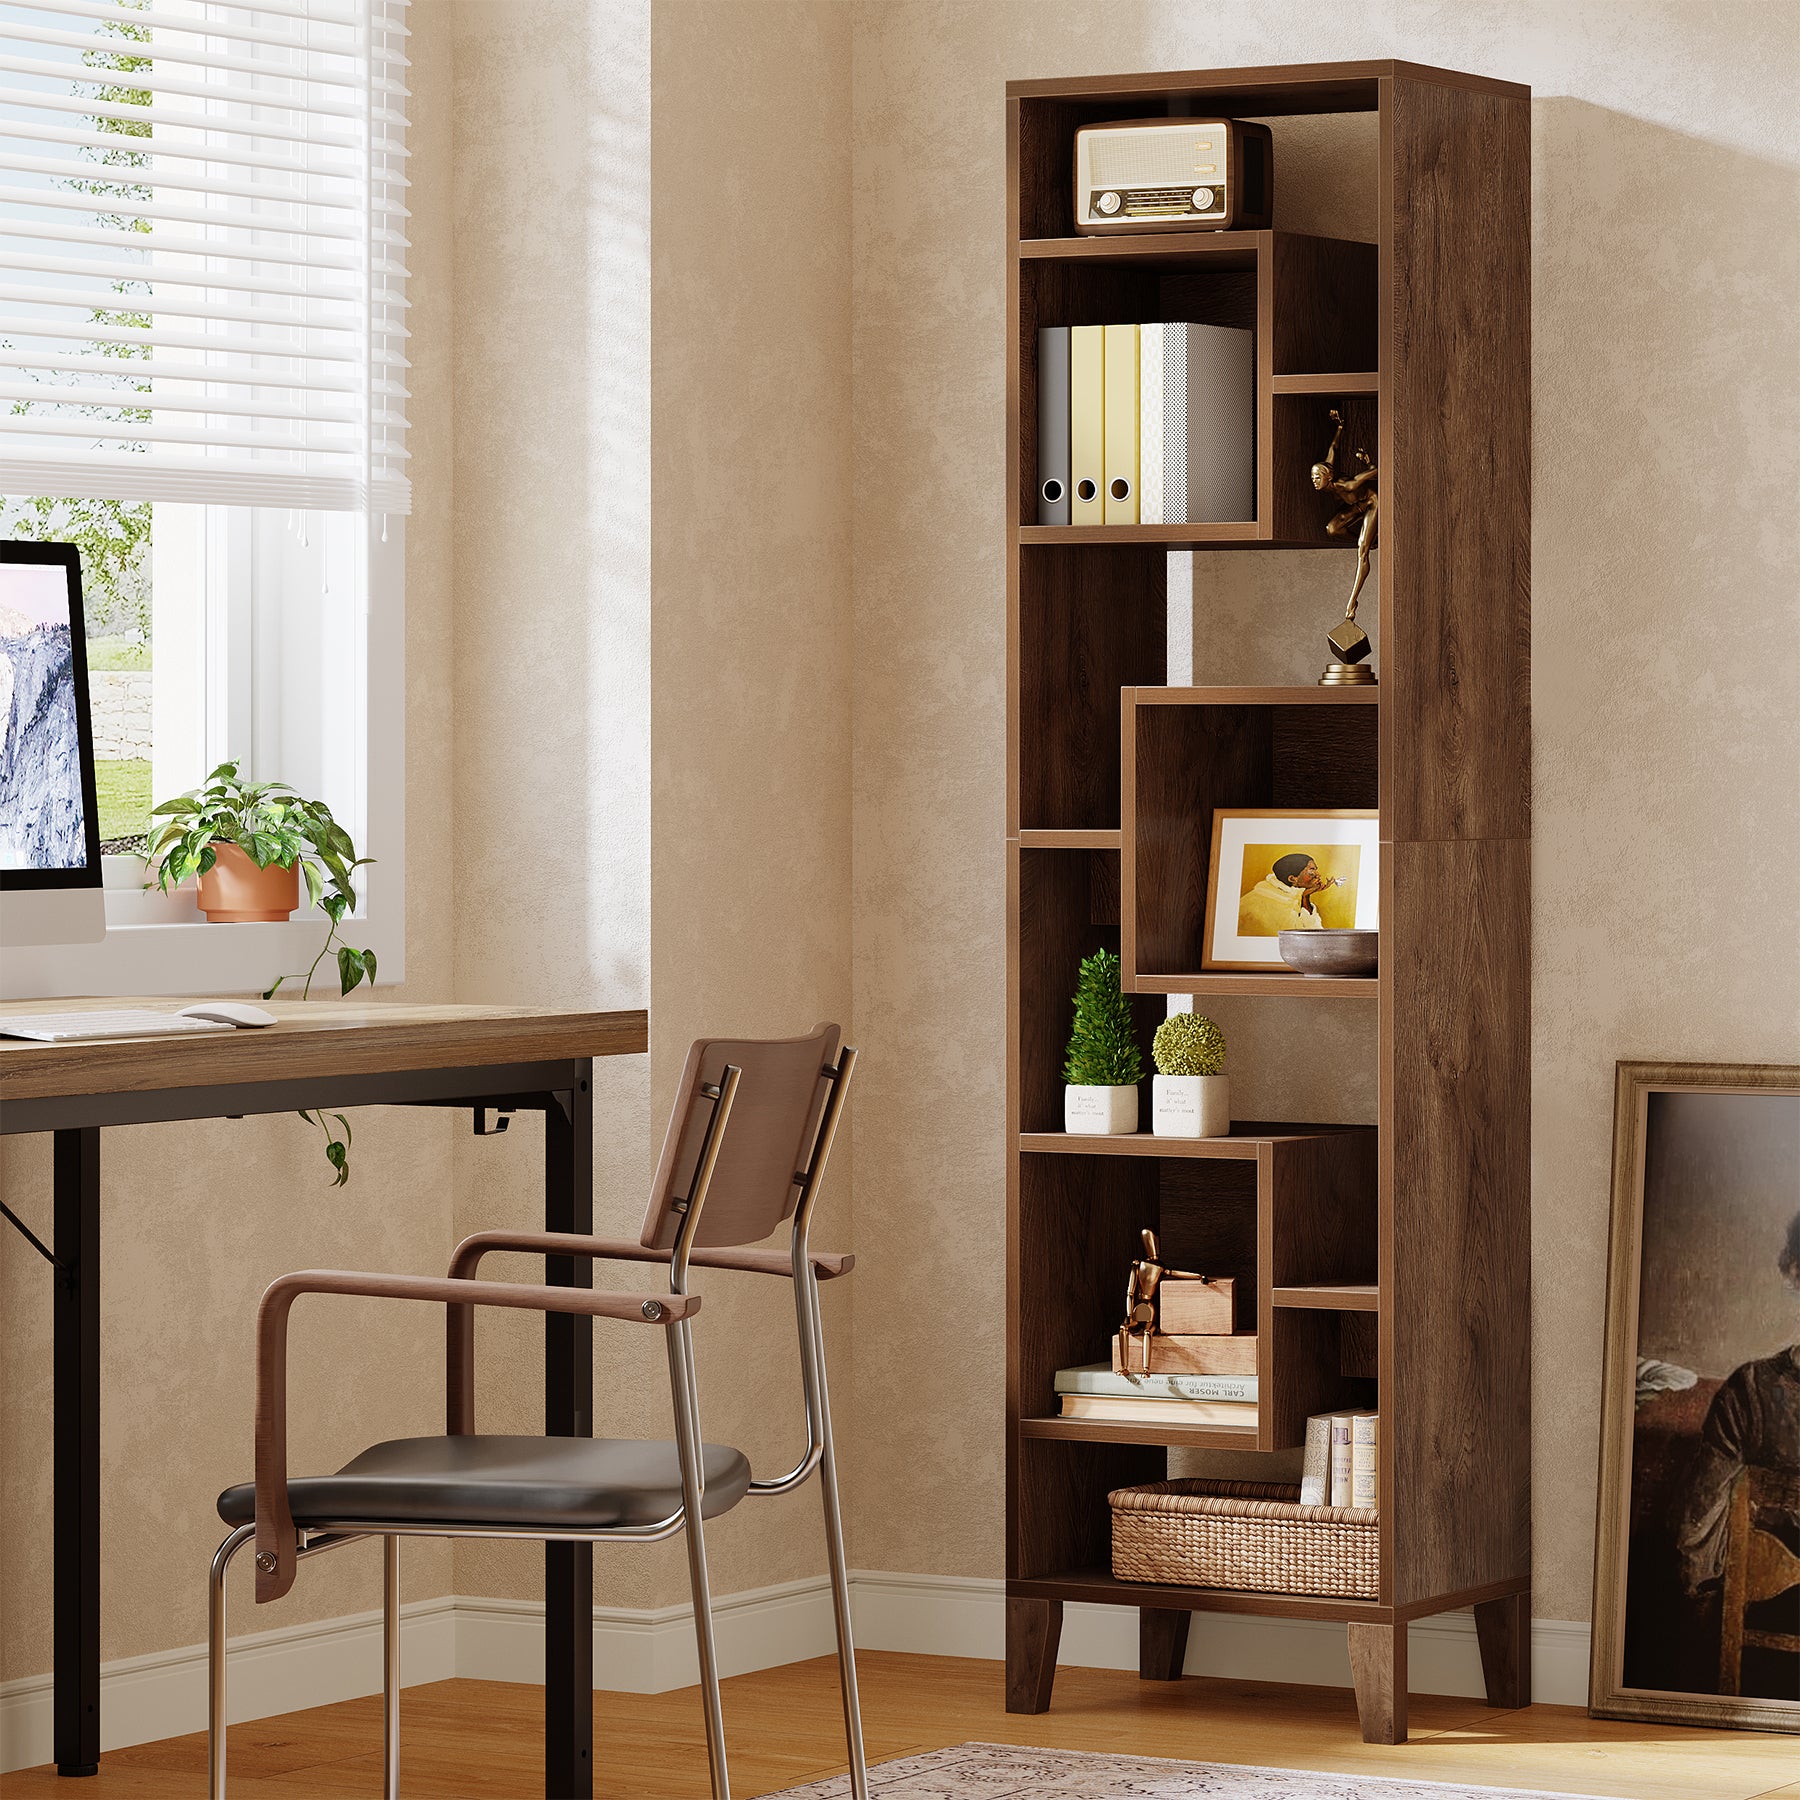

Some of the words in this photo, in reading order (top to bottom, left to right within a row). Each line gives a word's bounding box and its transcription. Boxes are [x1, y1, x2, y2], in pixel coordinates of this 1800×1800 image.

[1200, 1380, 1245, 1390] Architektur
[1189, 1387, 1219, 1396] MOSER
[1223, 1389, 1245, 1398] CARL
